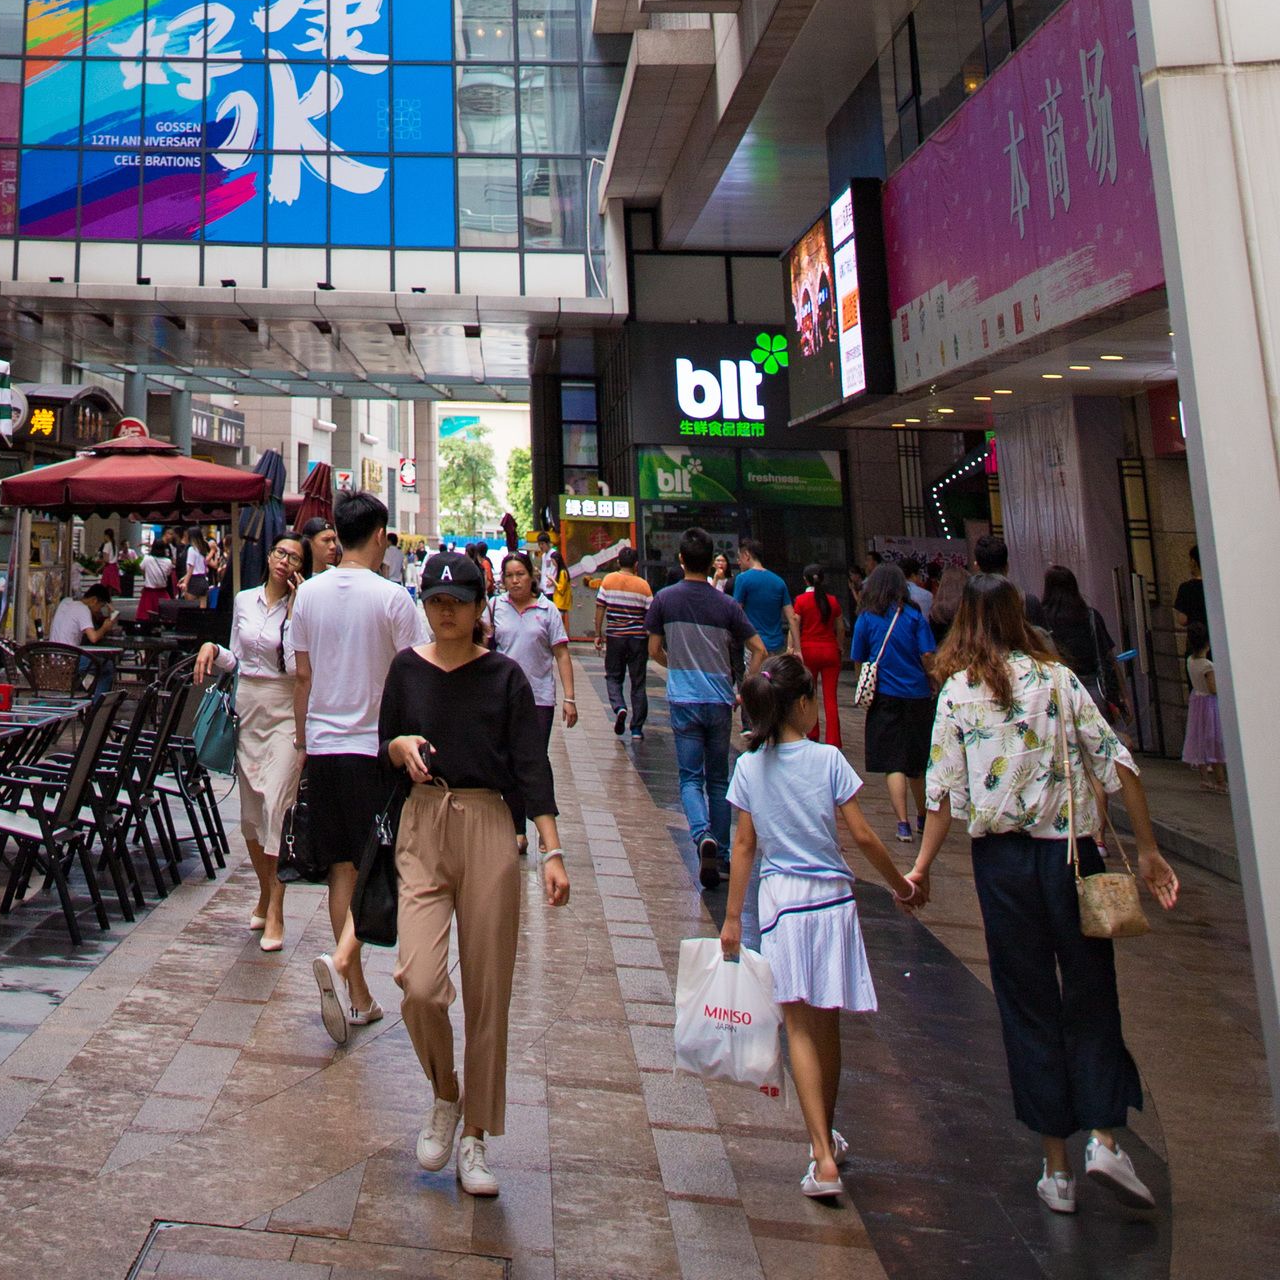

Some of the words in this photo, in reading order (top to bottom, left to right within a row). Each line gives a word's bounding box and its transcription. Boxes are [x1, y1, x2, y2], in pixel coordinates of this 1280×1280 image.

[155, 121, 202, 133] GOSSEN
[91, 134, 120, 147] 12TH
[122, 135, 202, 148] ANNIVERSARY
[114, 154, 201, 168] CELEBRATIONS
[675, 357, 766, 420] blt
[679, 420, 766, 438] 生鲜食品超市
[656, 467, 693, 493] blt
[565, 498, 630, 519] 绿色田园
[440, 565, 454, 582] A
[703, 1004, 753, 1026] MINISO
